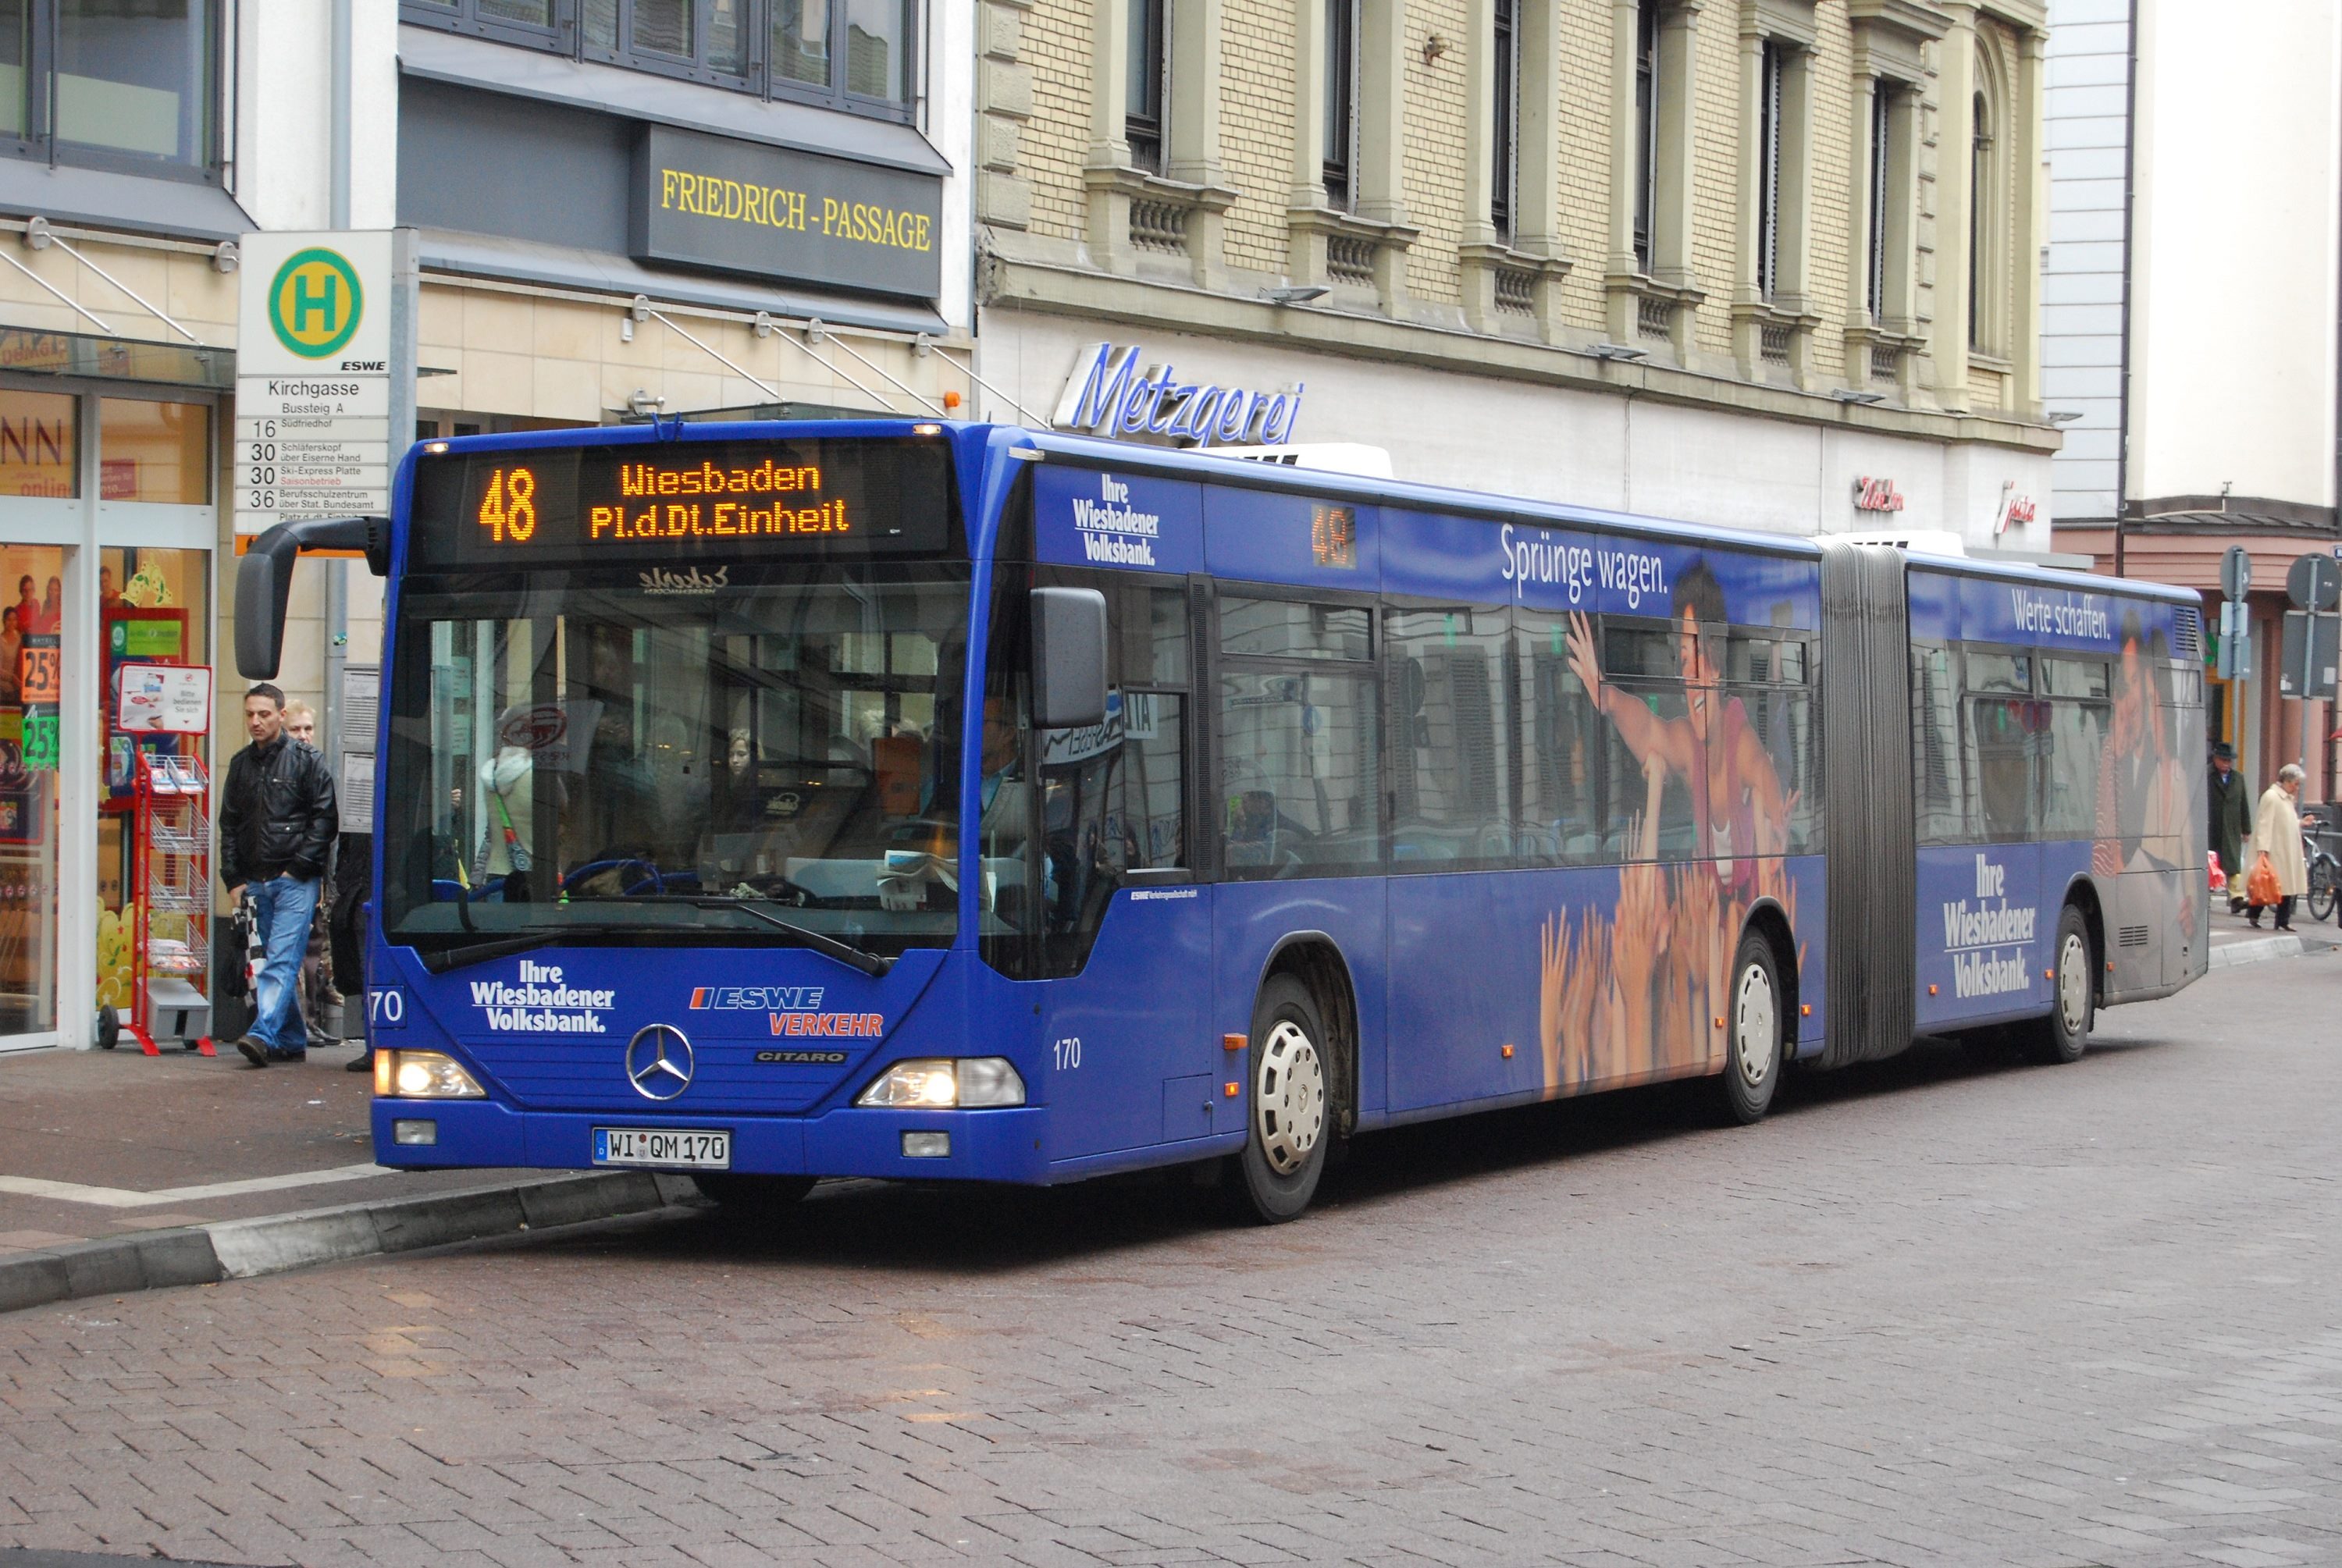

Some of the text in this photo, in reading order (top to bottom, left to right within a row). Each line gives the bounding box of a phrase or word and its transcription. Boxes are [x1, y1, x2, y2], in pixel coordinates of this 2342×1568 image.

[661, 169, 806, 231] FRIEDRICH
[823, 197, 931, 251] PASSAGE
[294, 276, 336, 332] H
[341, 361, 386, 371] ESWE
[269, 380, 359, 398] Kirchgasse
[1071, 341, 1304, 448] Metzgerei
[282, 403, 343, 415] Bussteig A
[254, 419, 332, 438] 16 Südfriedhof
[251, 443, 341, 461] 30 Schläferskopf
[280, 453, 301, 462] über
[337, 453, 361, 462] Hand
[251, 467, 361, 485] 30 Ski-Express Platte
[280, 477, 341, 485] Saisonbetrieb
[621, 460, 819, 495] Wiesbaden
[1101, 474, 1129, 503] Ihre
[250, 490, 368, 508] 36 Berufsschulzentrum
[279, 500, 374, 509] über Stat. Bundesamt
[479, 469, 535, 541] 48
[1073, 499, 1159, 535] Wiesbadener
[1084, 532, 1155, 566] Volksbank.
[1312, 508, 1347, 564] 48
[1500, 523, 1668, 610] Sprünge wagen.
[2012, 588, 2110, 640] Werte schaffen.
[1976, 854, 2004, 898] Ihre
[1944, 898, 2035, 948] Wiesbadener
[519, 960, 563, 983] Ihre
[1954, 948, 2029, 998] Volksbank.
[470, 981, 615, 1007] Wiesbadener
[714, 987, 824, 1009] ESWE
[486, 1008, 606, 1033] Volksbank.
[769, 1012, 884, 1036] VERKEHR
[756, 1053, 844, 1062] CITARO
[1053, 1036, 1080, 1071] 170
